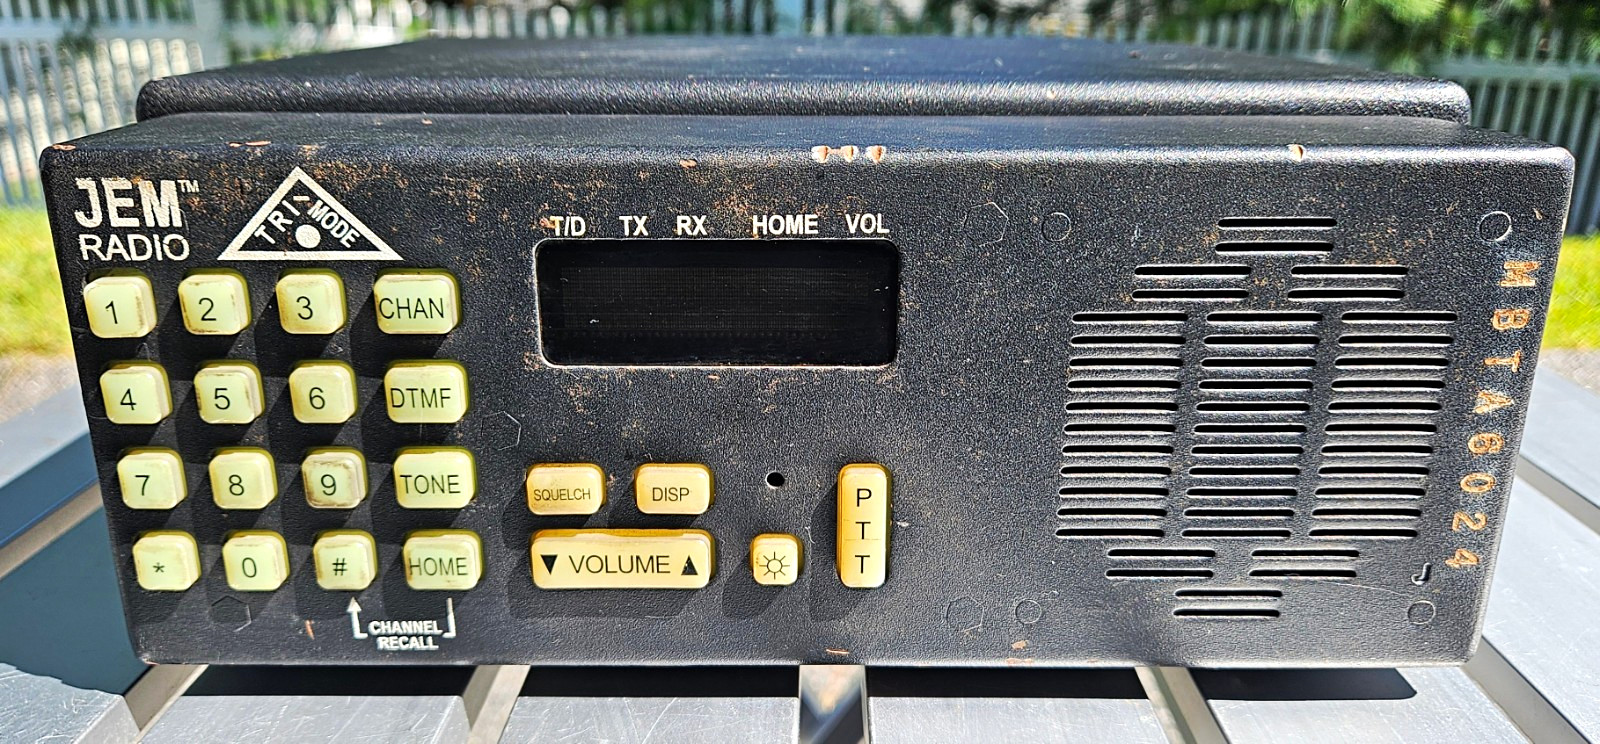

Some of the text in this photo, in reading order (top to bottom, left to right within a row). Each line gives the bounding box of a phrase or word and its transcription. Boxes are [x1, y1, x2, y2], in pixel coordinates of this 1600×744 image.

[549, 213, 890, 236] T/D TX RX HOME VOL
[79, 232, 190, 262] RADIO
[104, 301, 119, 325] 1
[200, 298, 217, 321] 2
[296, 296, 314, 320] 3
[378, 298, 445, 319] CHAN
[119, 388, 137, 411] 4
[214, 388, 231, 410] 5
[309, 387, 326, 410] 6
[390, 388, 452, 408] DTMF
[135, 475, 150, 496] 7
[229, 474, 245, 497] 8
[320, 474, 337, 496] 9
[400, 475, 461, 494] TONE
[533, 488, 591, 501] SQUELCH
[652, 487, 690, 502] DISP
[241, 557, 257, 578] 0
[332, 558, 348, 576] #
[409, 557, 468, 576] HOME
[568, 555, 671, 574] VOLUME
[368, 620, 443, 637] CHANNEL
[377, 636, 439, 651] RECALL
